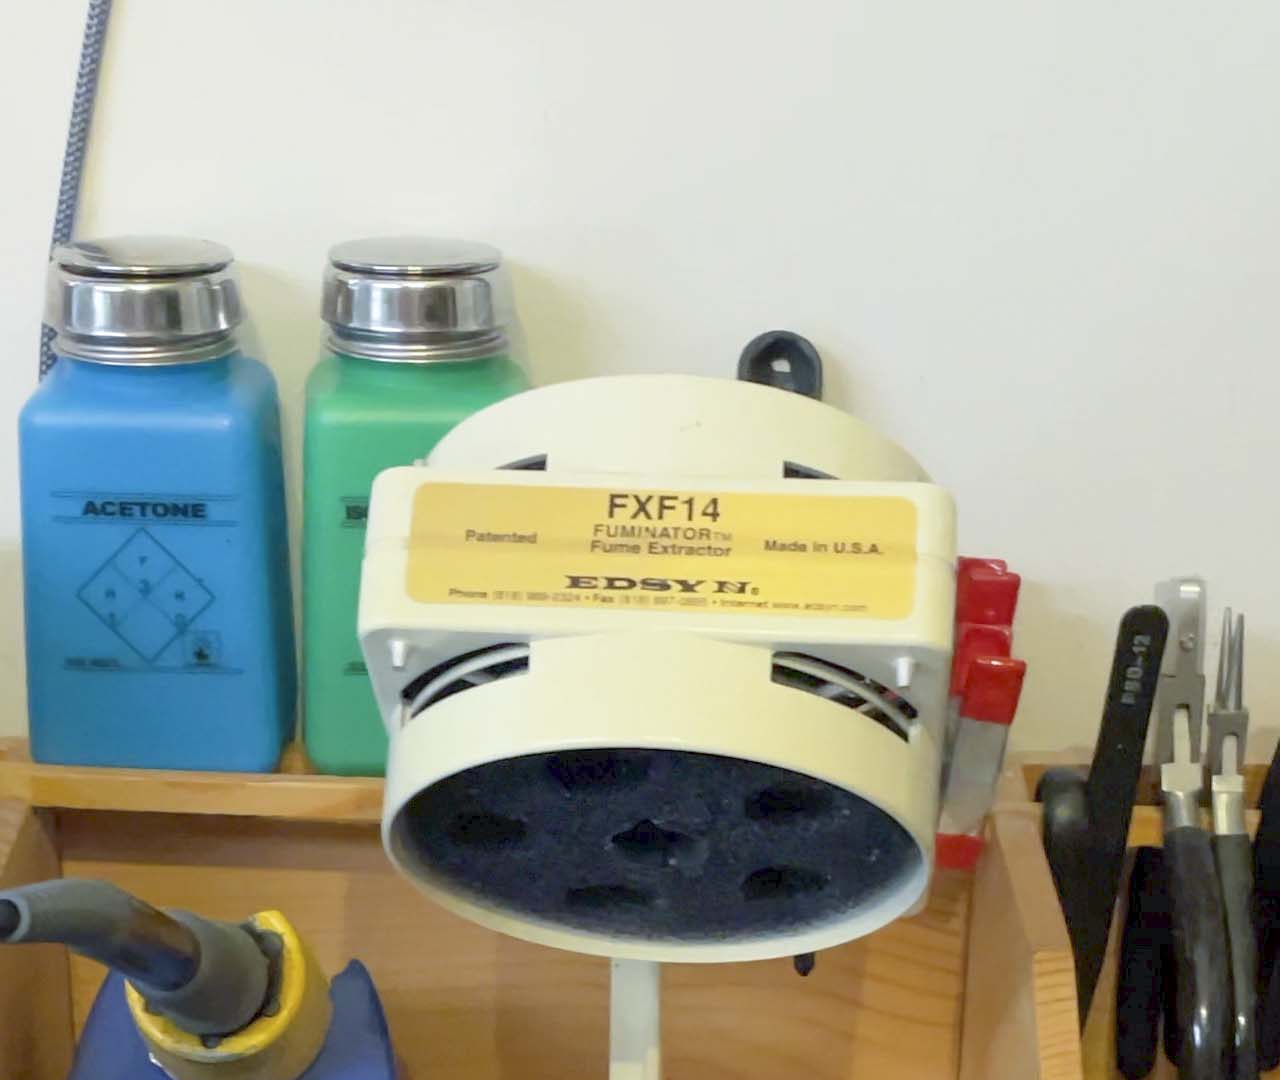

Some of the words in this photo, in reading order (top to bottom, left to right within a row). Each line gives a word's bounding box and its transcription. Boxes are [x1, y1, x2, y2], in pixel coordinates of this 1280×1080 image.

[81, 501, 208, 519] ACETONE
[607, 493, 721, 522] FXF14
[464, 529, 538, 545] Patented
[590, 539, 642, 555] Fume
[646, 540, 733, 558] Extractor
[763, 539, 808, 553] Made
[812, 540, 828, 553] in
[832, 542, 885, 556] U.S.A.
